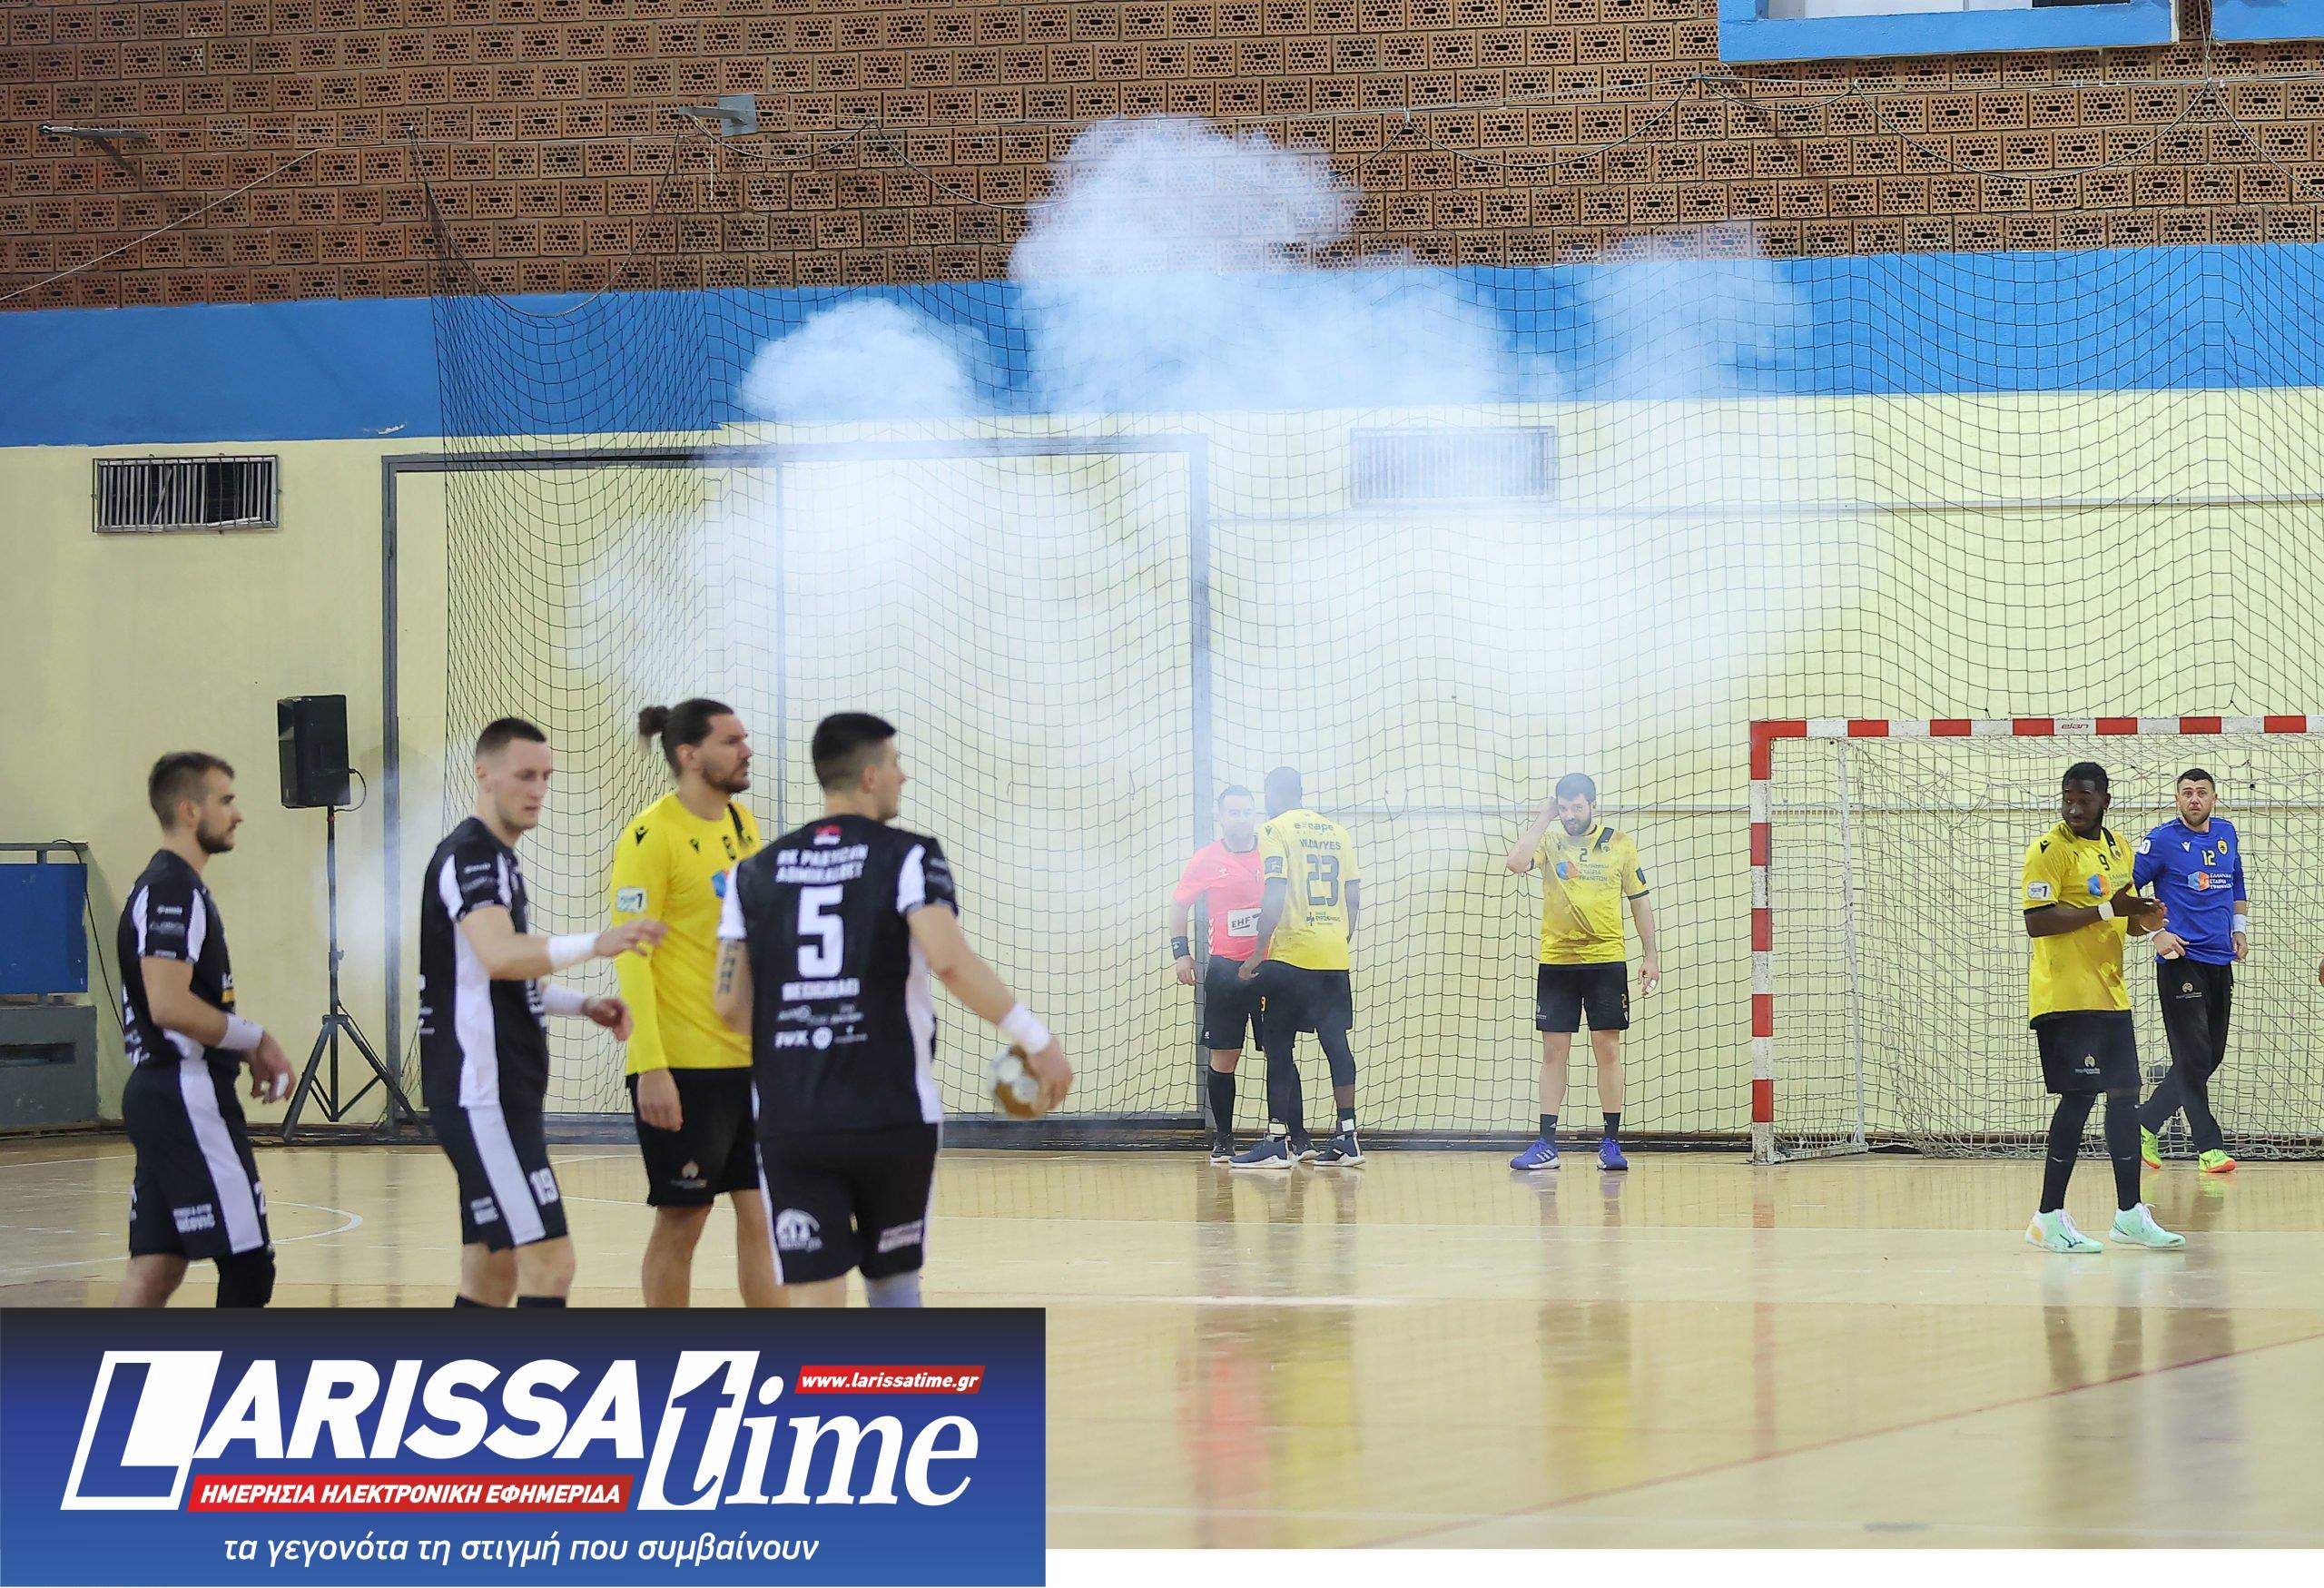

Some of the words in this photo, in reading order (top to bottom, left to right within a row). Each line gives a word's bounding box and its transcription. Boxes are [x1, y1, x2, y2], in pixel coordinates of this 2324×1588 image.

[1580, 848, 1588, 863] 2
[2098, 853, 2110, 871] 9
[2201, 850, 2216, 866] 12
[1306, 854, 1340, 907] 23
[1231, 916, 1251, 928] EHF
[797, 884, 844, 978] 5
